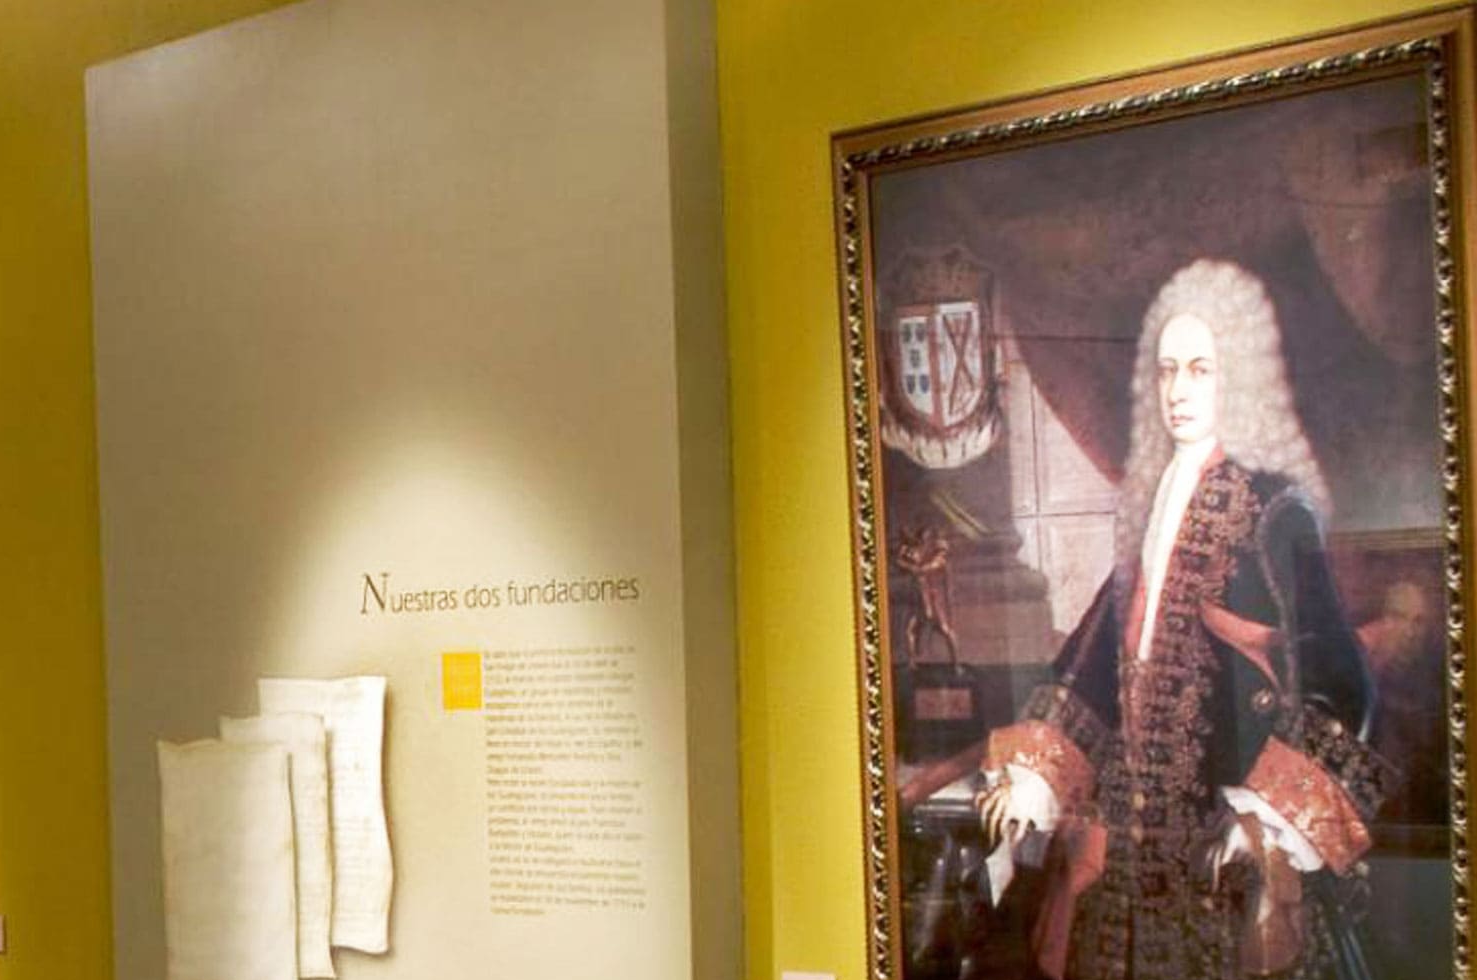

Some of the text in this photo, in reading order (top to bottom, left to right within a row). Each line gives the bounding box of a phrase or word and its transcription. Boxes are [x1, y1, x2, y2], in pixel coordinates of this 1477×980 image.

[360, 572, 640, 614] Nuestras dos fundaciones
